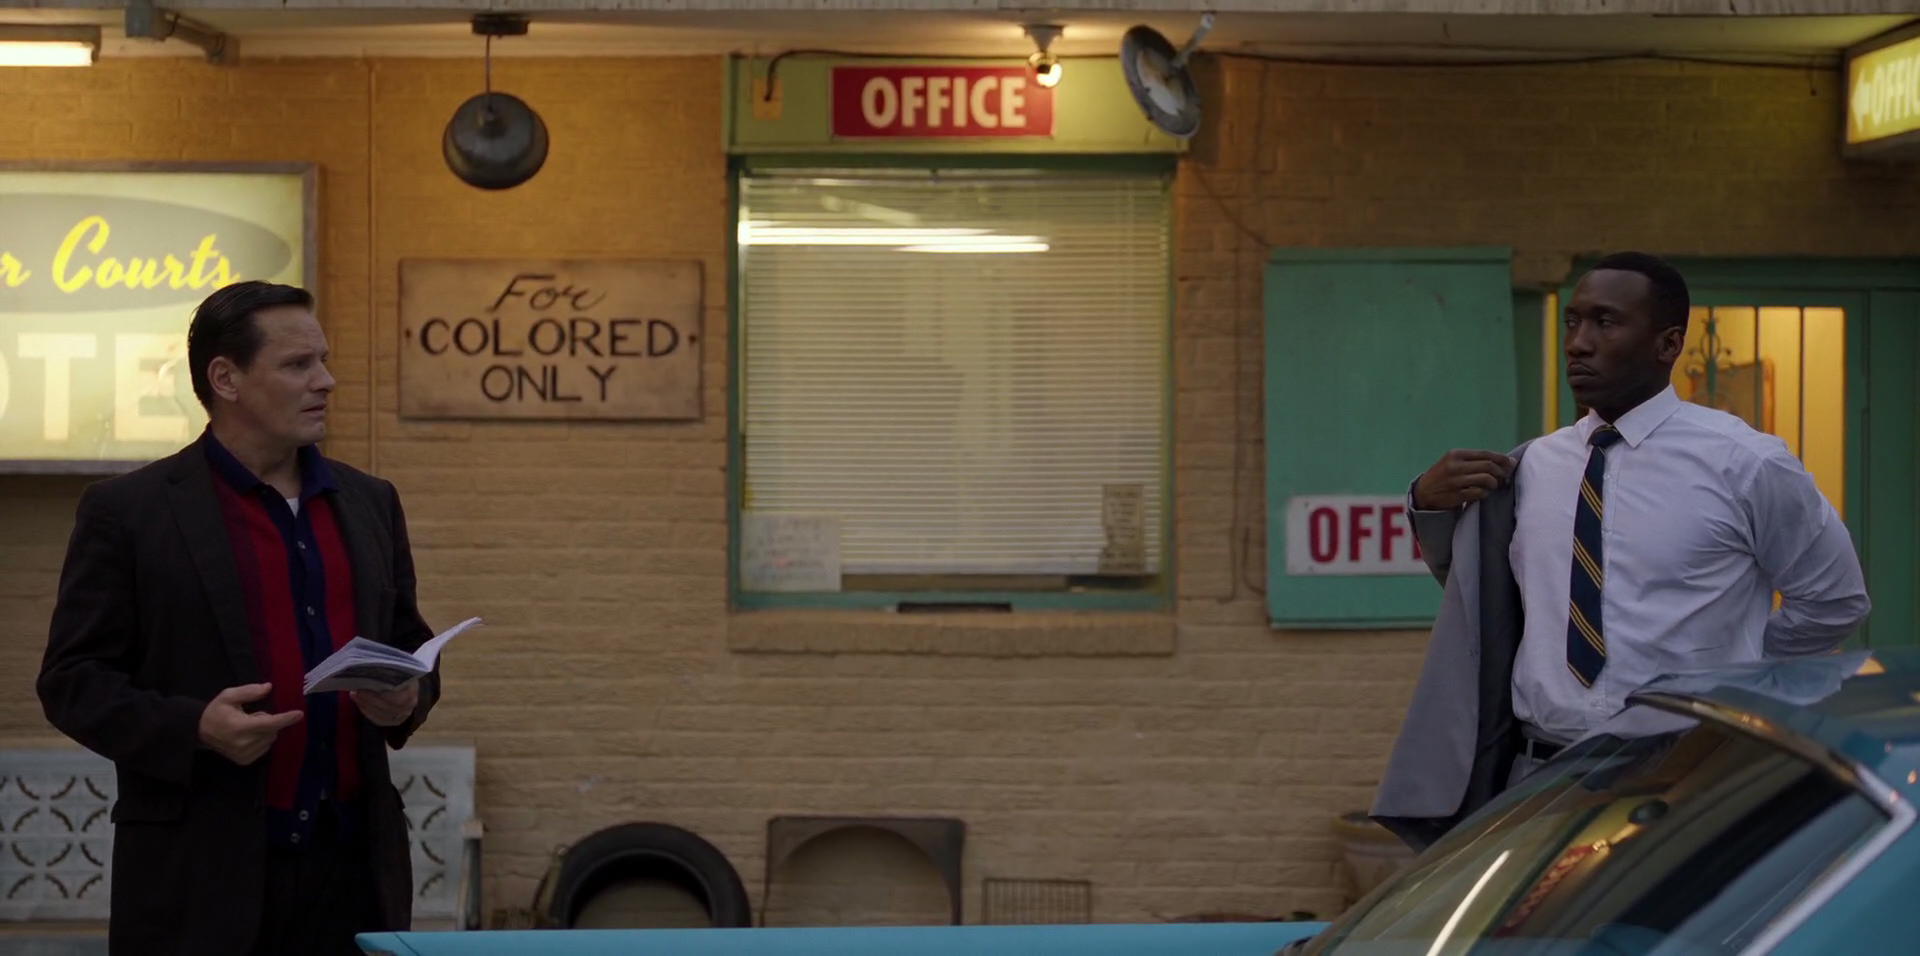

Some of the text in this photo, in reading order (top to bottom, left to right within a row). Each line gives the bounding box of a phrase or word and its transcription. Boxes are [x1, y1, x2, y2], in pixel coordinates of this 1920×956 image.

[861, 76, 1027, 128] OFFICE
[0, 215, 240, 293] r Courts
[486, 274, 608, 313] For
[419, 317, 680, 357] COLORED
[0, 333, 190, 442] TE
[480, 364, 618, 402] ONLY
